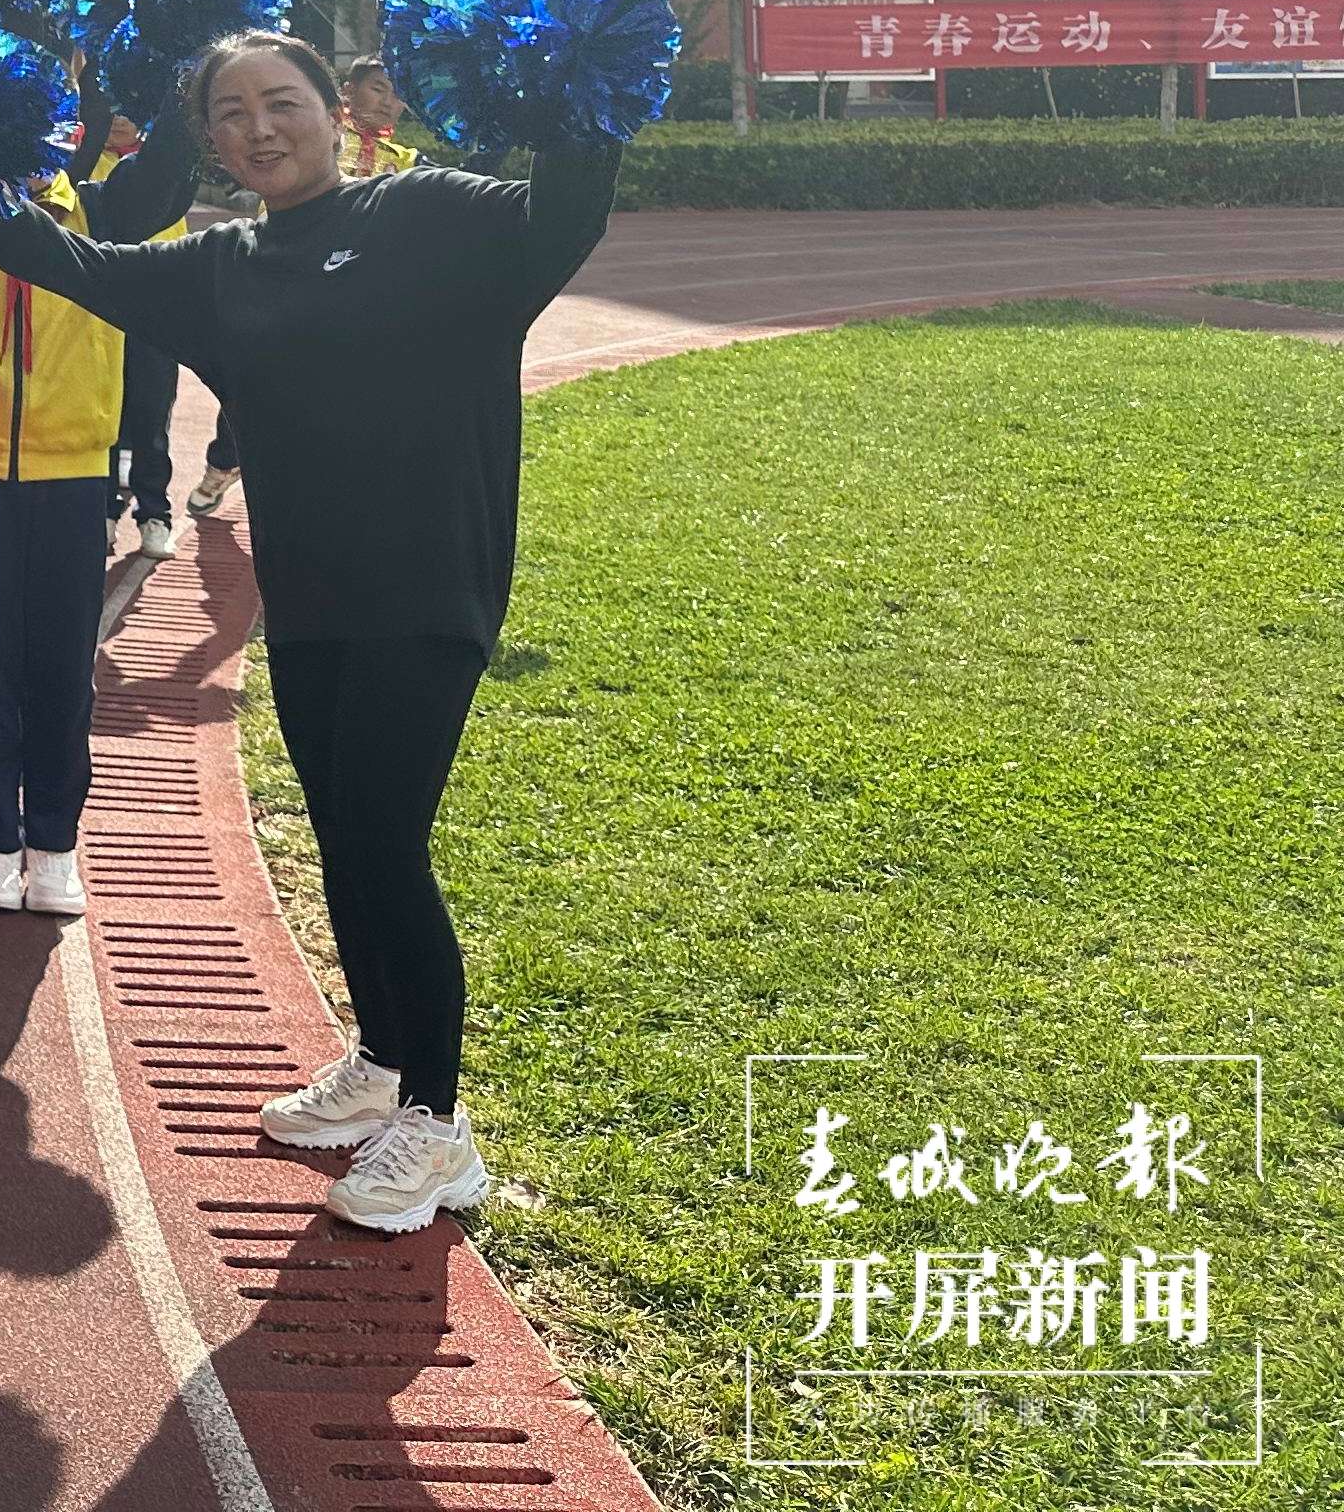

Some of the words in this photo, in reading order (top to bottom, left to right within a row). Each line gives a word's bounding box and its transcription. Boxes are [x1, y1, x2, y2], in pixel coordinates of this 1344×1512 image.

[853, 5, 1344, 59] 青春运动、友谊
